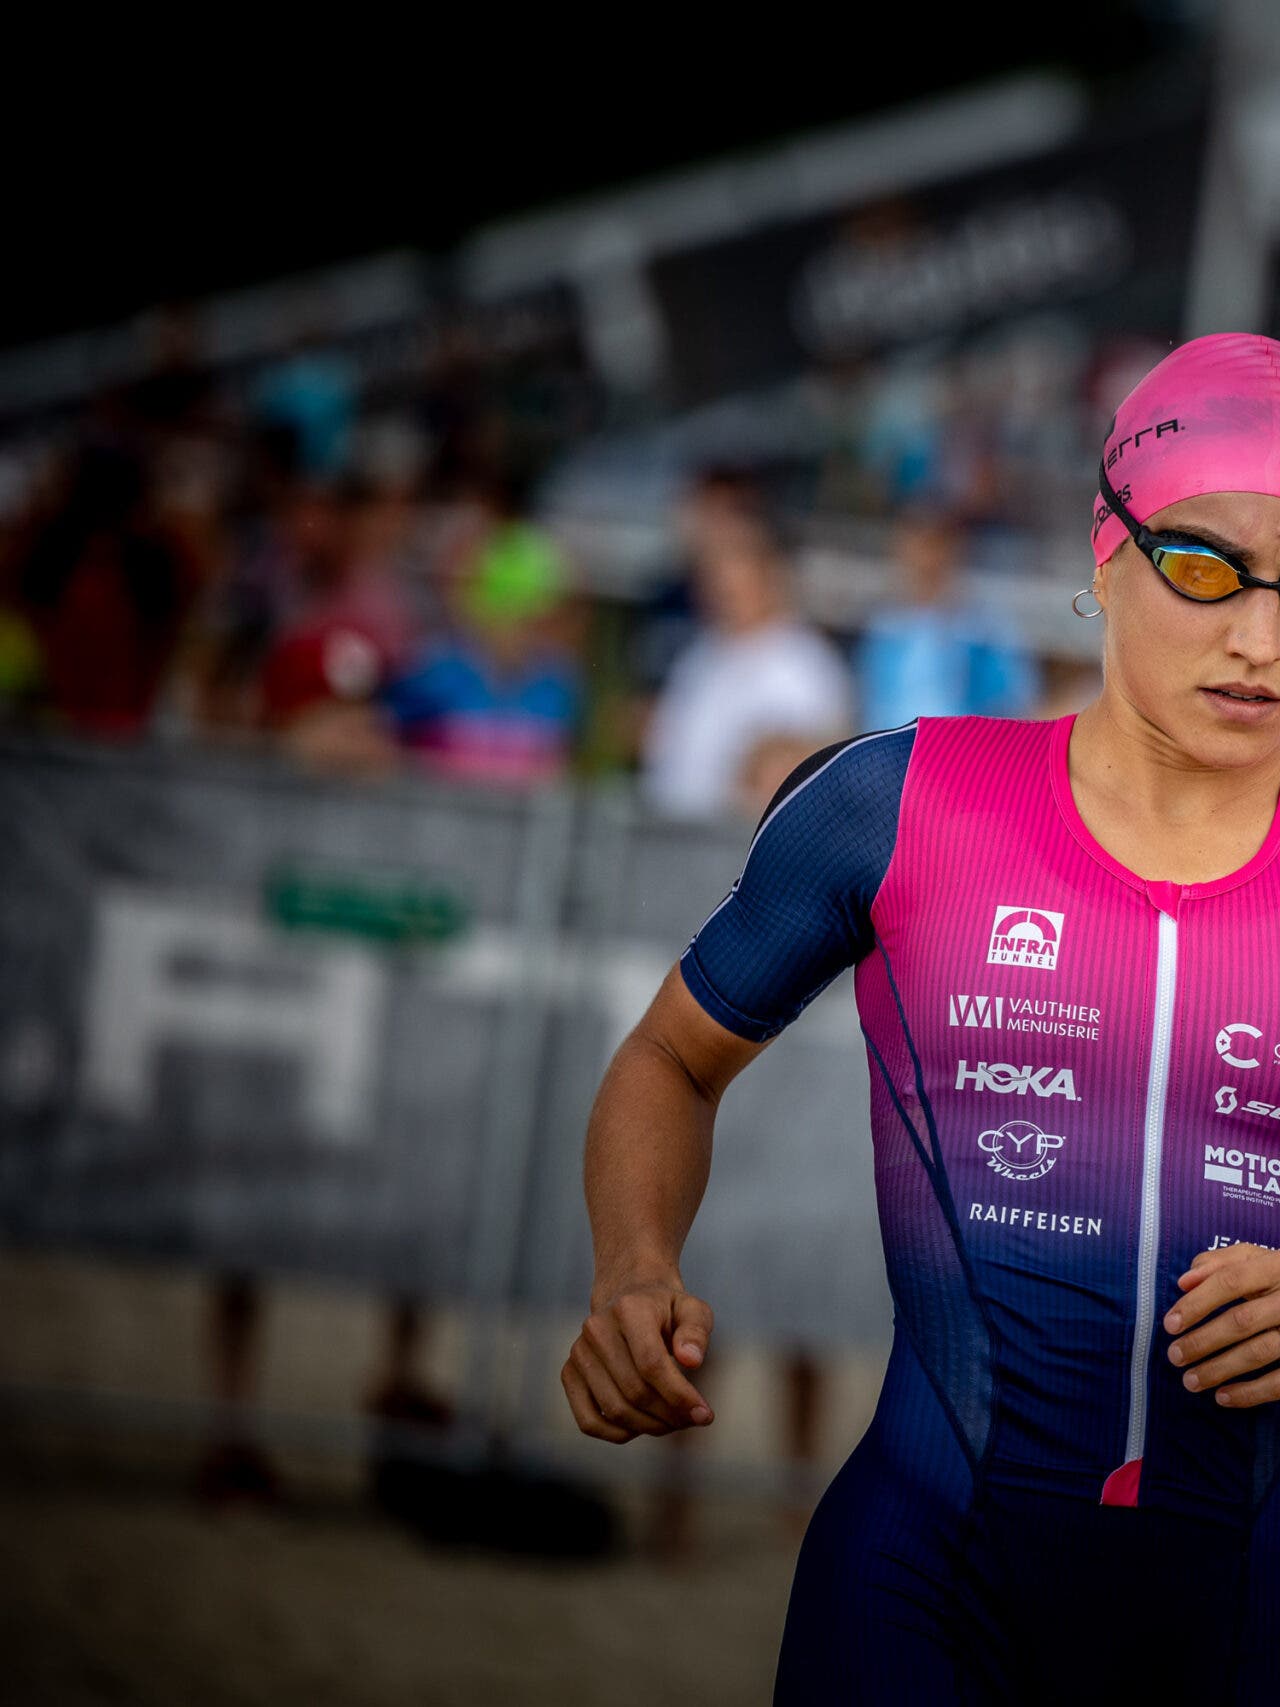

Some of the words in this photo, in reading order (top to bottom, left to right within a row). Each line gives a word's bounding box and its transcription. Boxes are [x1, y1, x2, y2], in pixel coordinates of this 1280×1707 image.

[992, 936, 1055, 956] INFRA
[991, 952, 1054, 967] TUNNEL
[1009, 998, 1101, 1024] VAUTHIER
[1007, 1018, 1100, 1041] MENUISERIE
[977, 1130, 1064, 1155] CYP
[969, 1202, 1102, 1236] RAIFFEISEN
